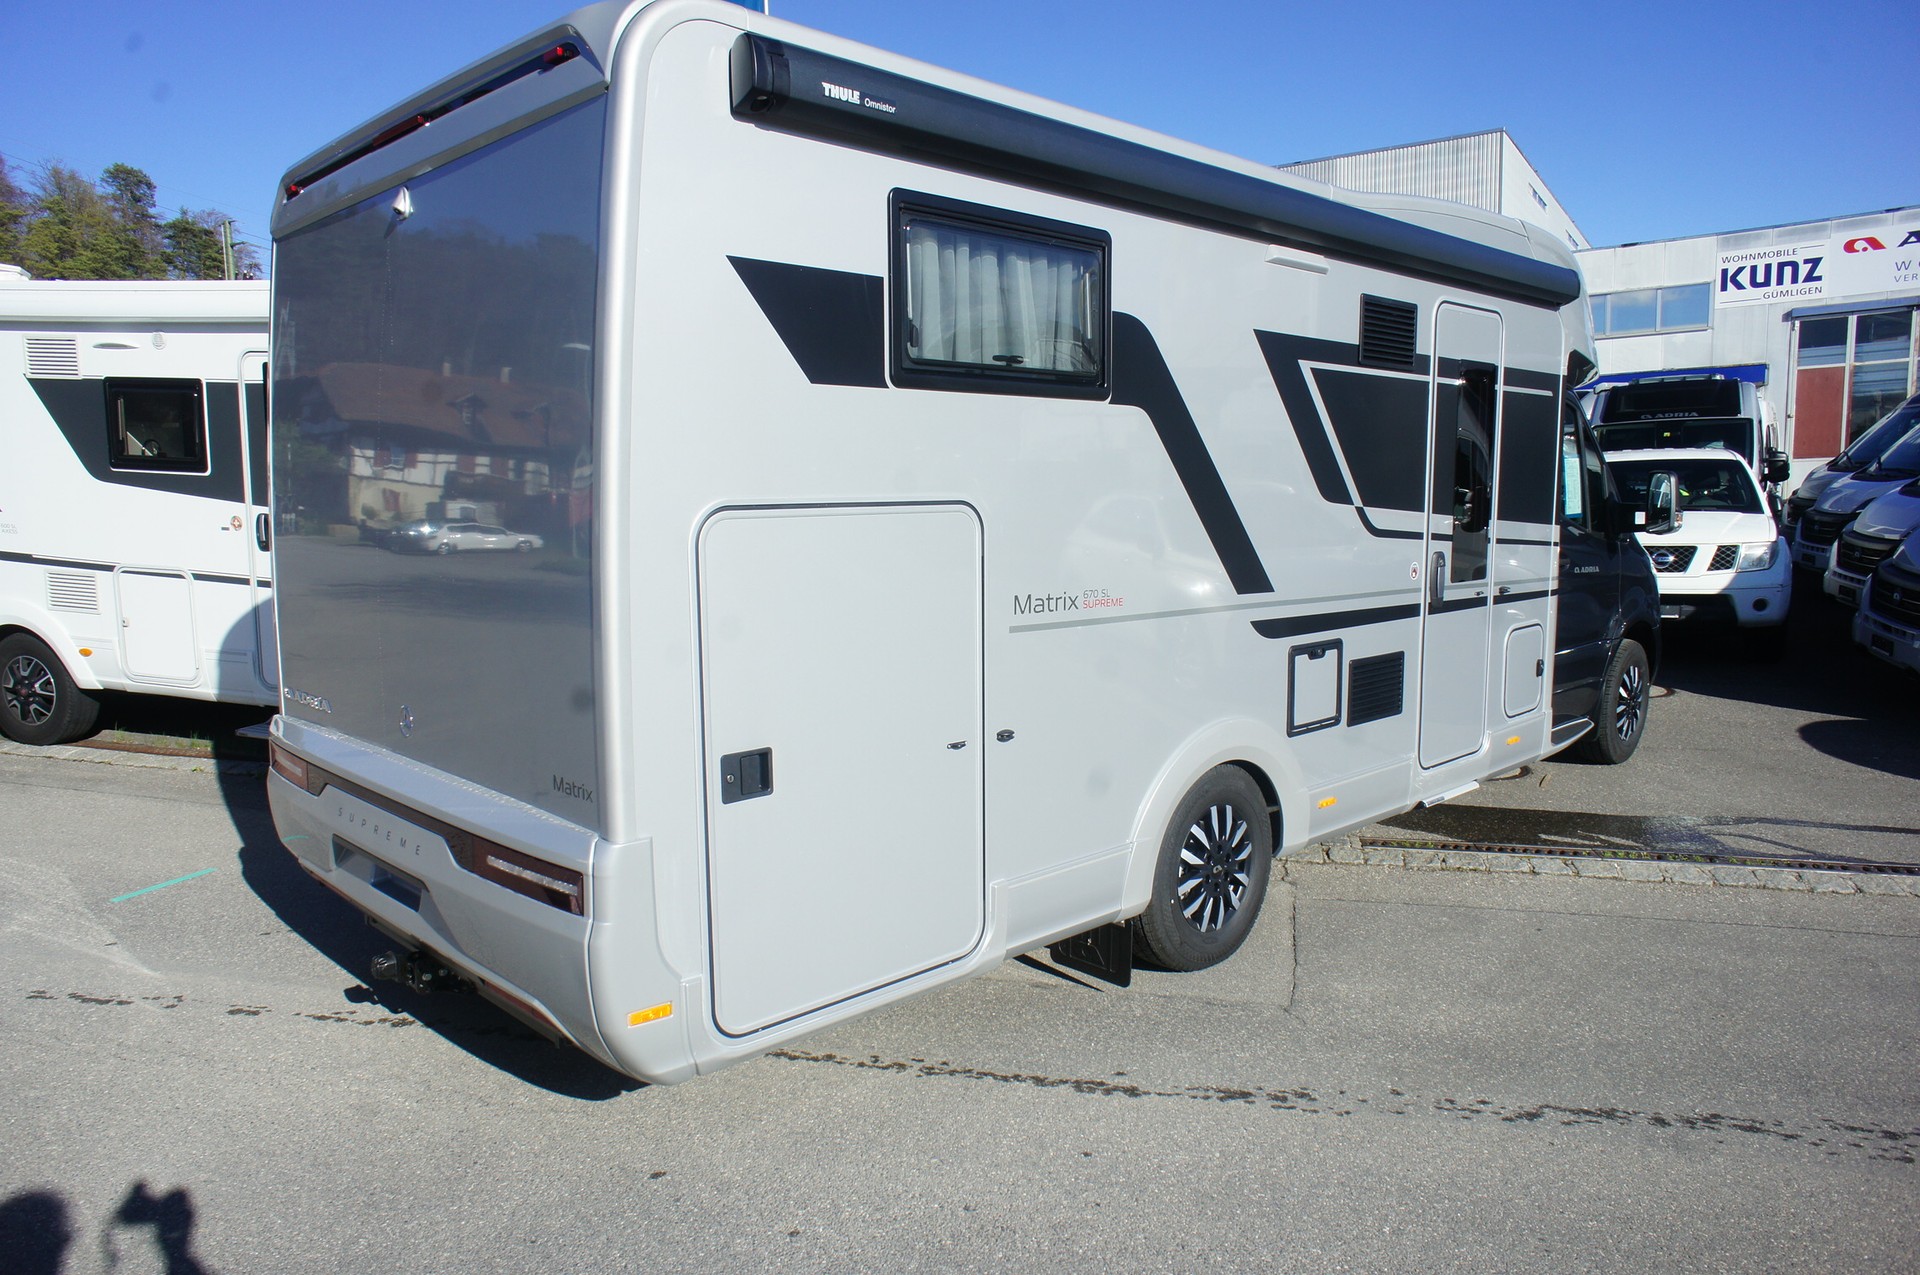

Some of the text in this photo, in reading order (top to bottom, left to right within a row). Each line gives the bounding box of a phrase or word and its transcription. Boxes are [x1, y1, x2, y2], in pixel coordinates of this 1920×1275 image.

[821, 81, 896, 114] THULE Omnistor
[1721, 247, 1798, 264] WOHNMOBILE
[1762, 286, 1823, 300] GÜMLIGEN
[1654, 411, 1699, 419] ADRIA
[1013, 588, 1111, 615] Matrix 670 SL
[1082, 597, 1124, 609] SUPREME
[553, 774, 593, 803] Matrix
[338, 807, 421, 855] SUPREME
